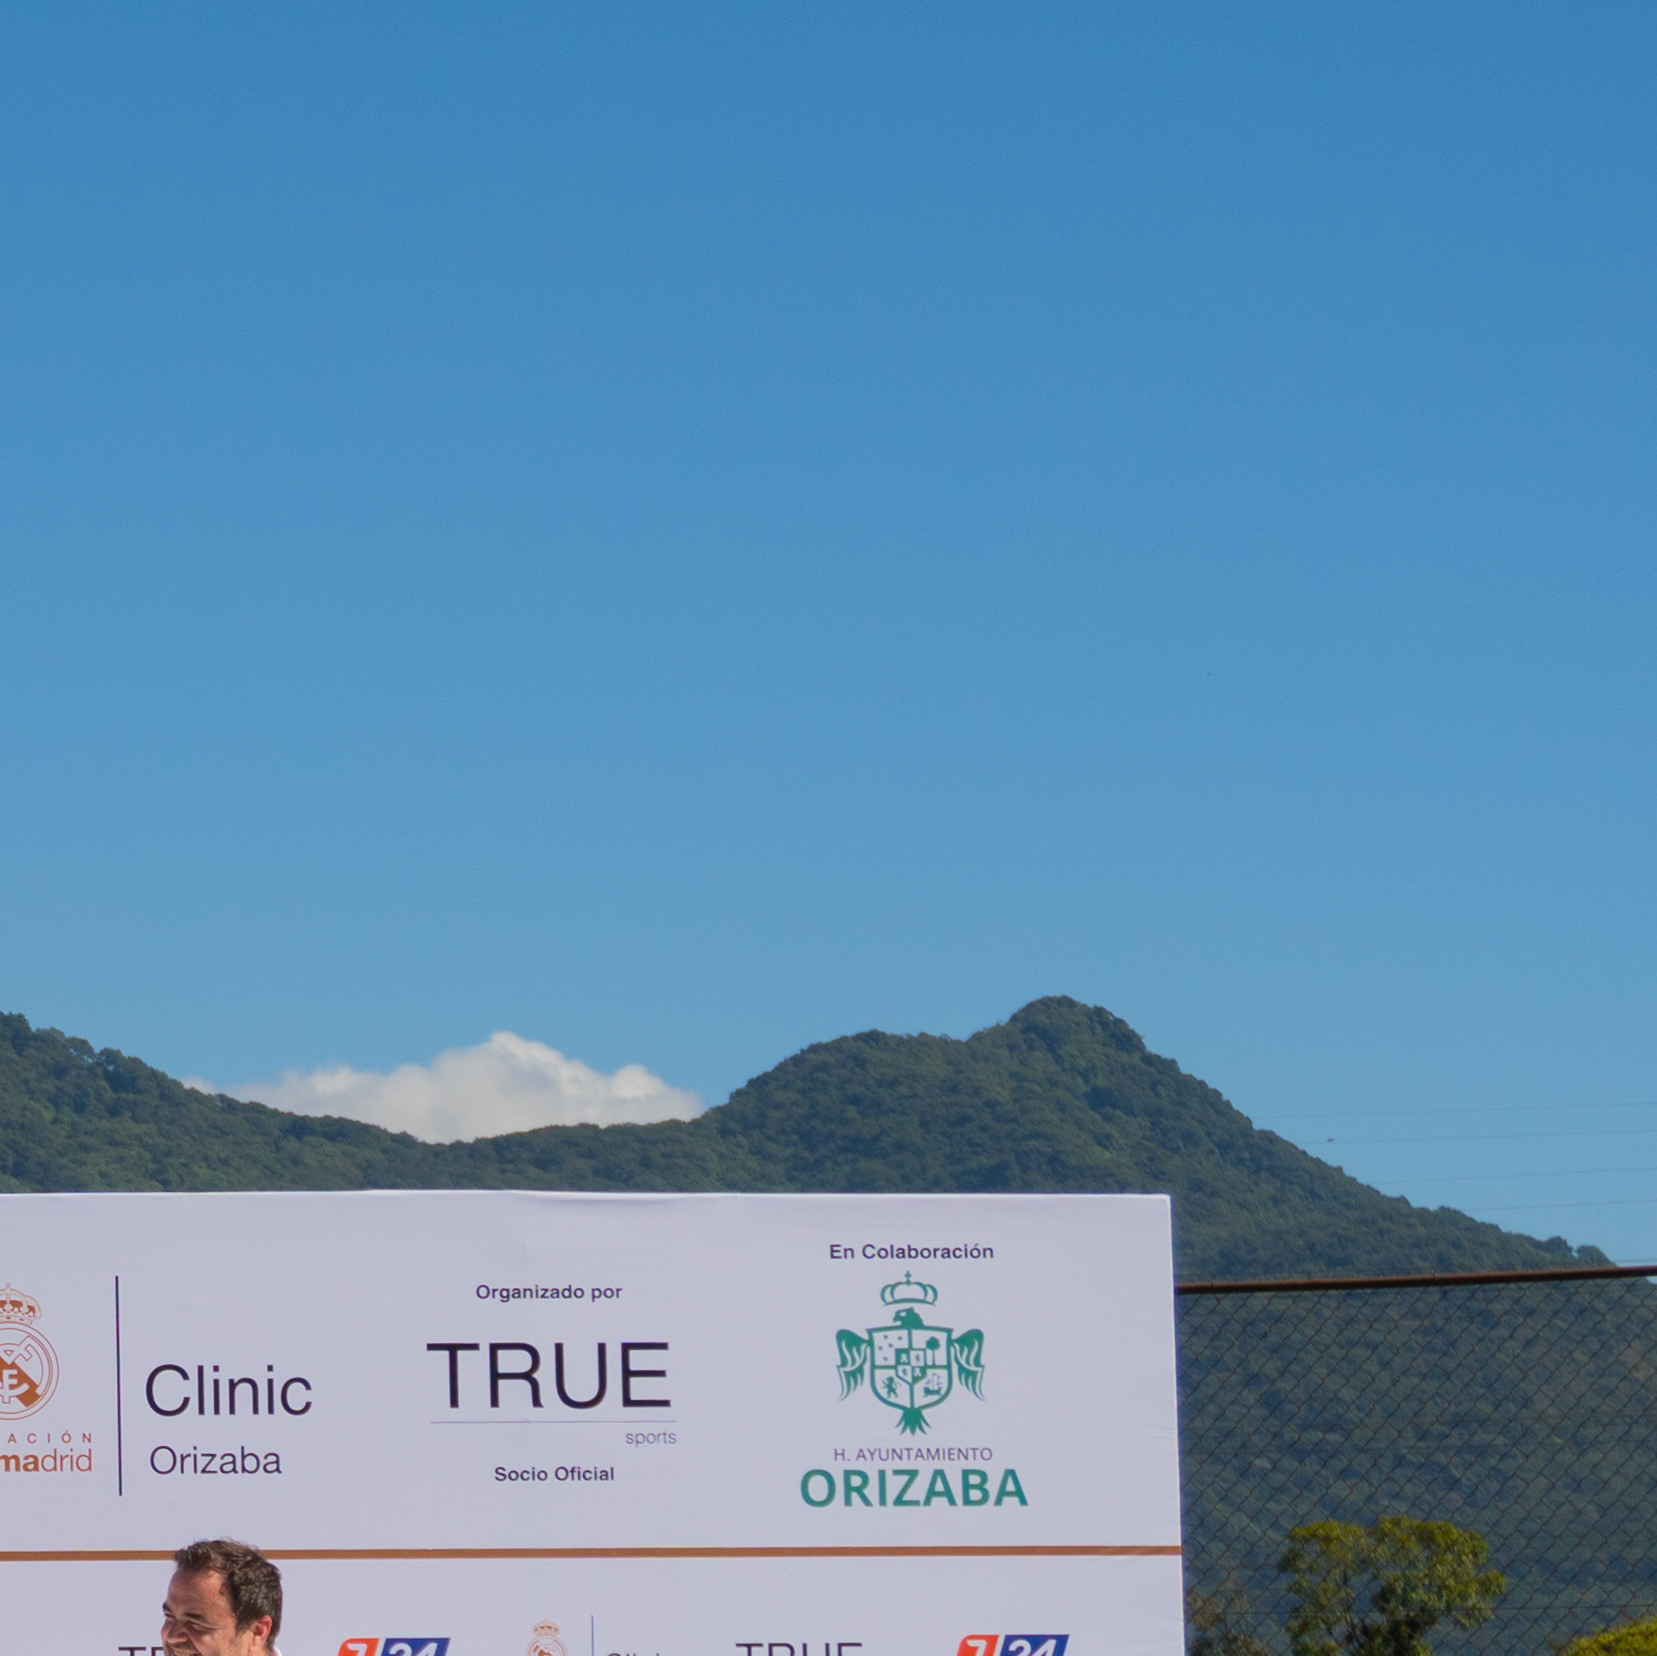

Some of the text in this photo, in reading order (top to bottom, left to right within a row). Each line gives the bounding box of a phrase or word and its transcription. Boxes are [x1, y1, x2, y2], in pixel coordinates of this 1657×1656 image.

[830, 1244, 993, 1259] En Colaboración
[476, 1285, 622, 1302] Organizado por
[427, 1342, 670, 1409] TRUE
[146, 1364, 311, 1416] Clinic
[626, 1432, 677, 1447] sports
[150, 1446, 282, 1474] Orizaba
[834, 1448, 992, 1461] H. AYUNTAMIENTO
[495, 1467, 614, 1481] Socio Oficial
[801, 1469, 1028, 1507] ORIZABA
